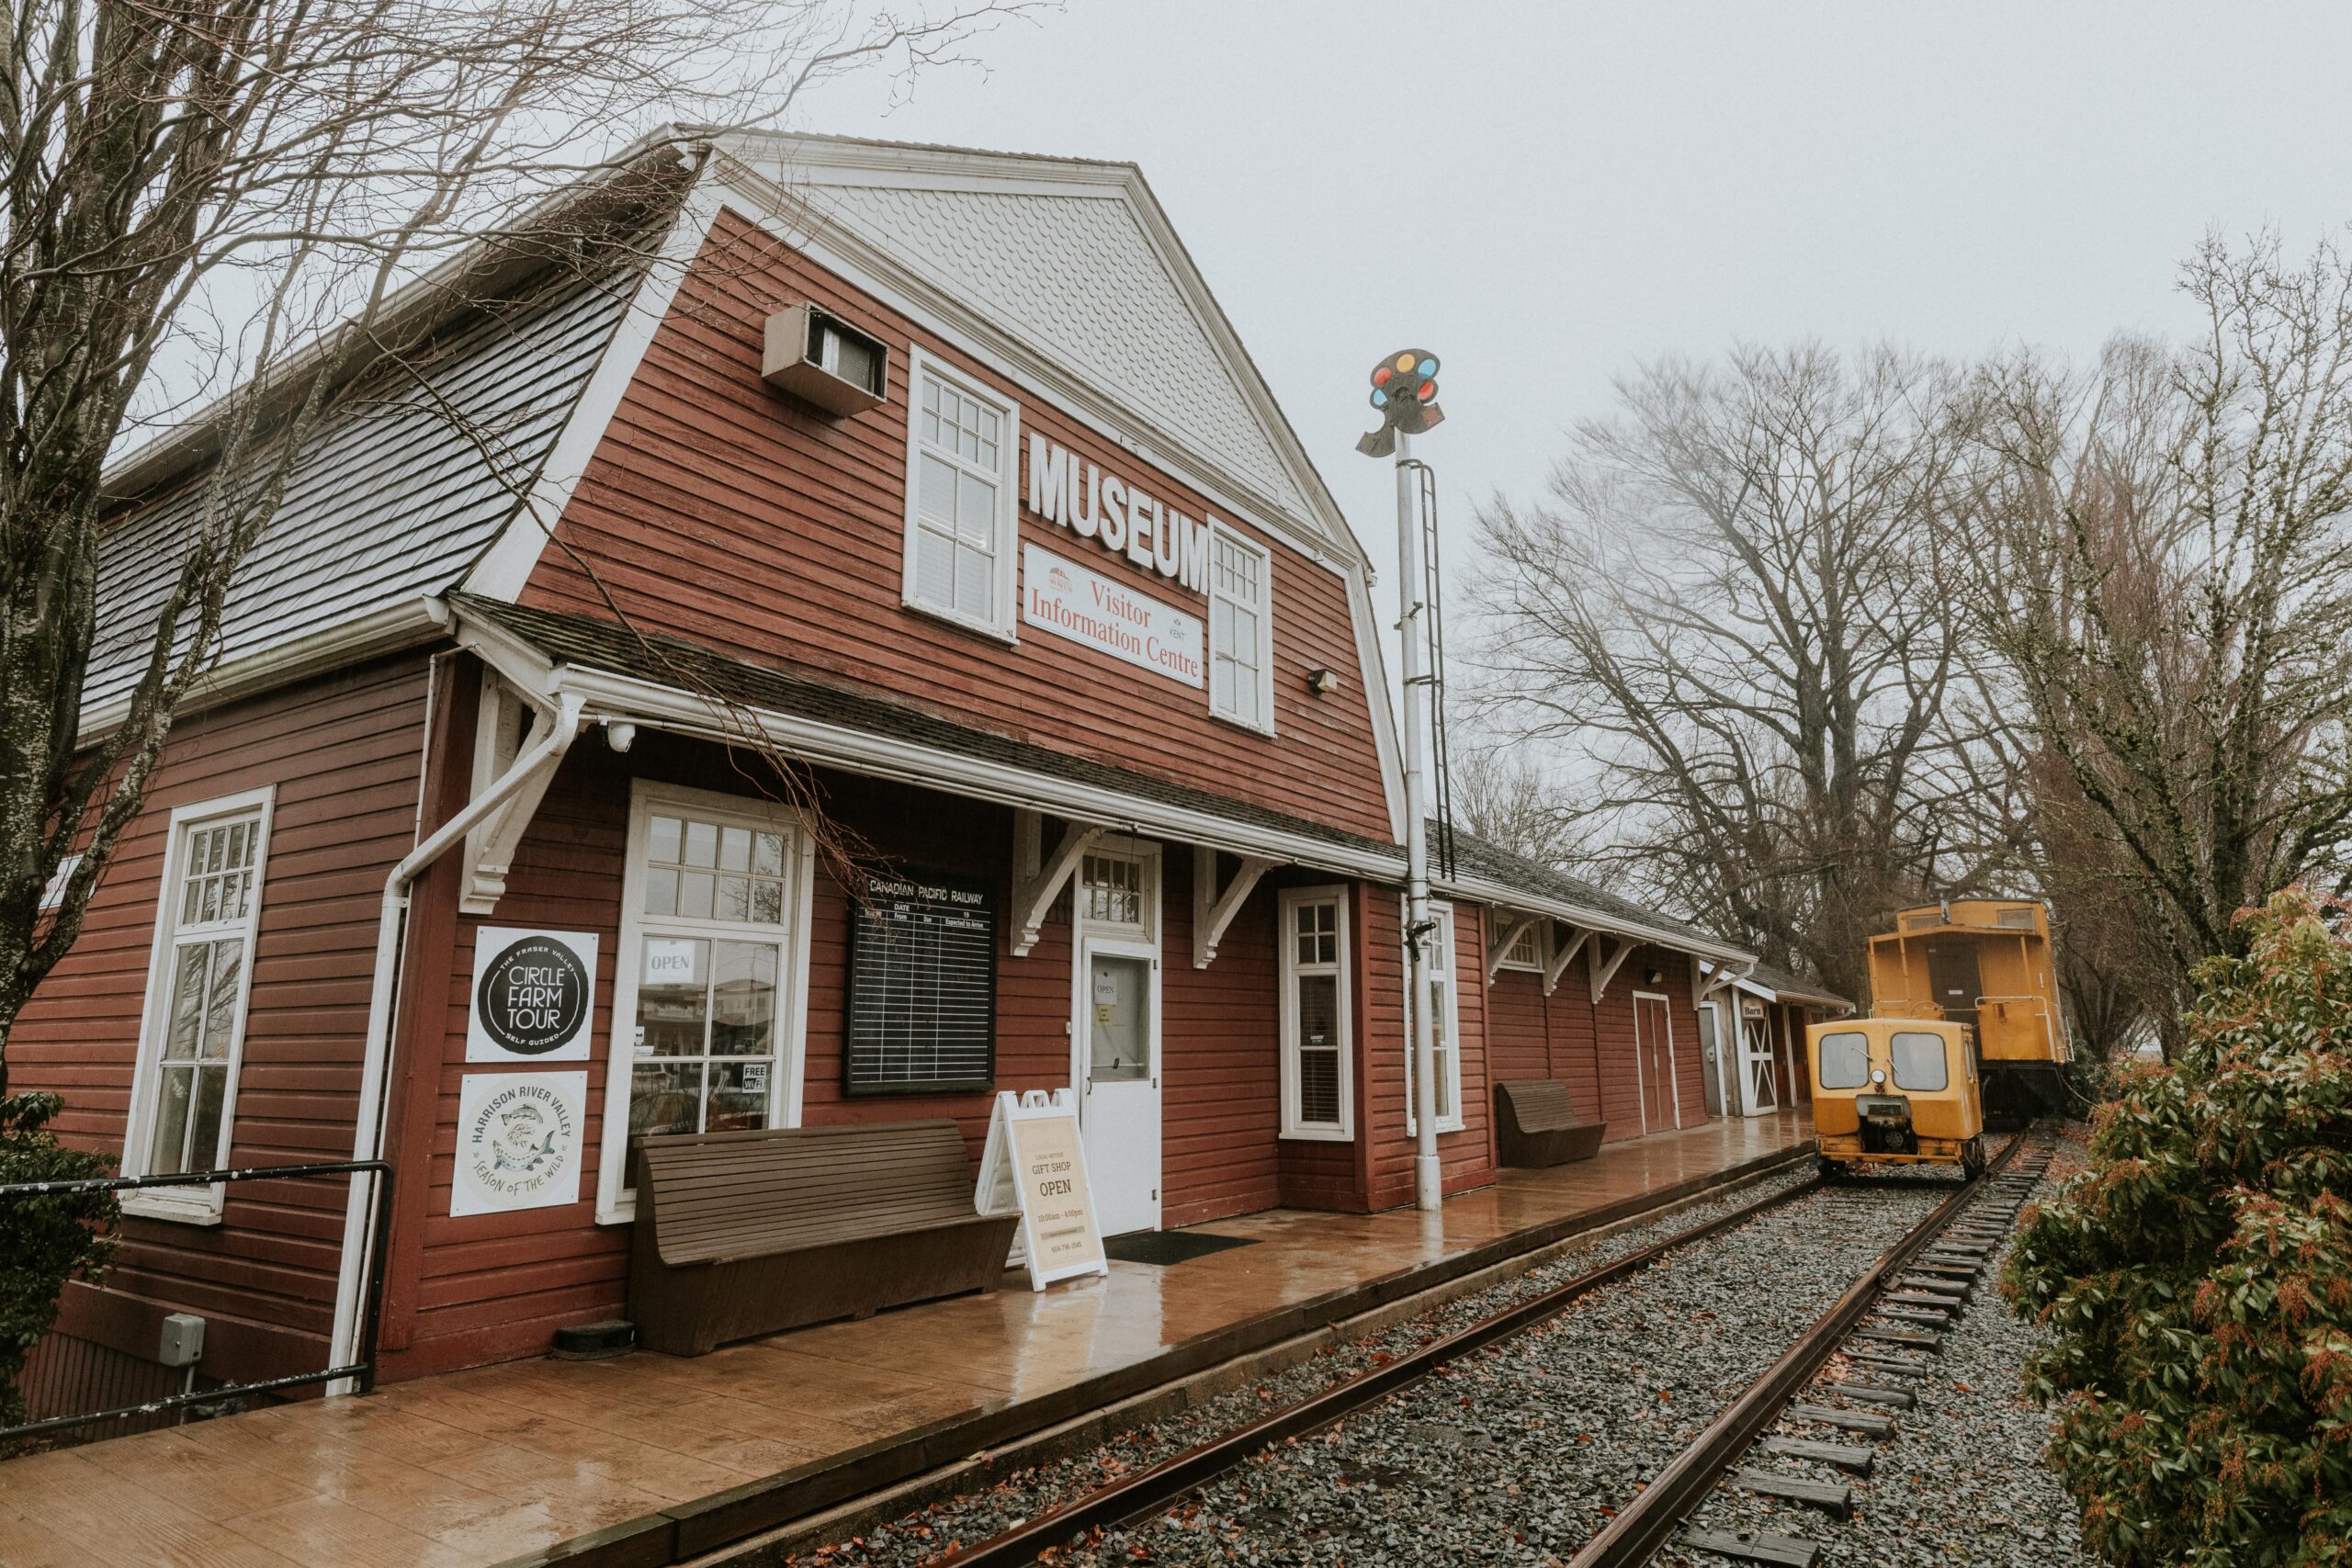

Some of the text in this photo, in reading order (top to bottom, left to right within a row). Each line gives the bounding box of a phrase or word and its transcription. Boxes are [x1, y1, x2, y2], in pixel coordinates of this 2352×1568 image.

[1029, 432, 1209, 596] MUSEUM
[1091, 580, 1151, 628] Visitor
[1031, 587, 1199, 678] Information Centre
[1169, 626, 1185, 641] KENT
[869, 880, 983, 905] CANADIAN PACIFIC RAILWAY
[894, 903, 910, 912] DATE
[894, 912, 908, 920] From
[945, 919, 966, 928] Expected
[499, 945, 575, 973] THE FRASER VALLEY
[650, 955, 689, 971] OPEN
[508, 965, 565, 987] CIRCLE
[507, 987, 562, 1008] FARM
[1097, 985, 1114, 993] OPEN
[1745, 1006, 1761, 1015] Barn
[507, 1009, 560, 1030] TOUR
[505, 1032, 560, 1046] SELF GUIDED
[745, 1066, 765, 1076] FREE
[472, 1086, 571, 1144] HARRISON RIVER VALLEY
[473, 1155, 565, 1197] SEASON OF THE WILD
[1032, 1161, 1071, 1175] GIFT SHOP
[1039, 1179, 1071, 1197] OPEN
[1037, 1213, 1060, 1223] 10:00am
